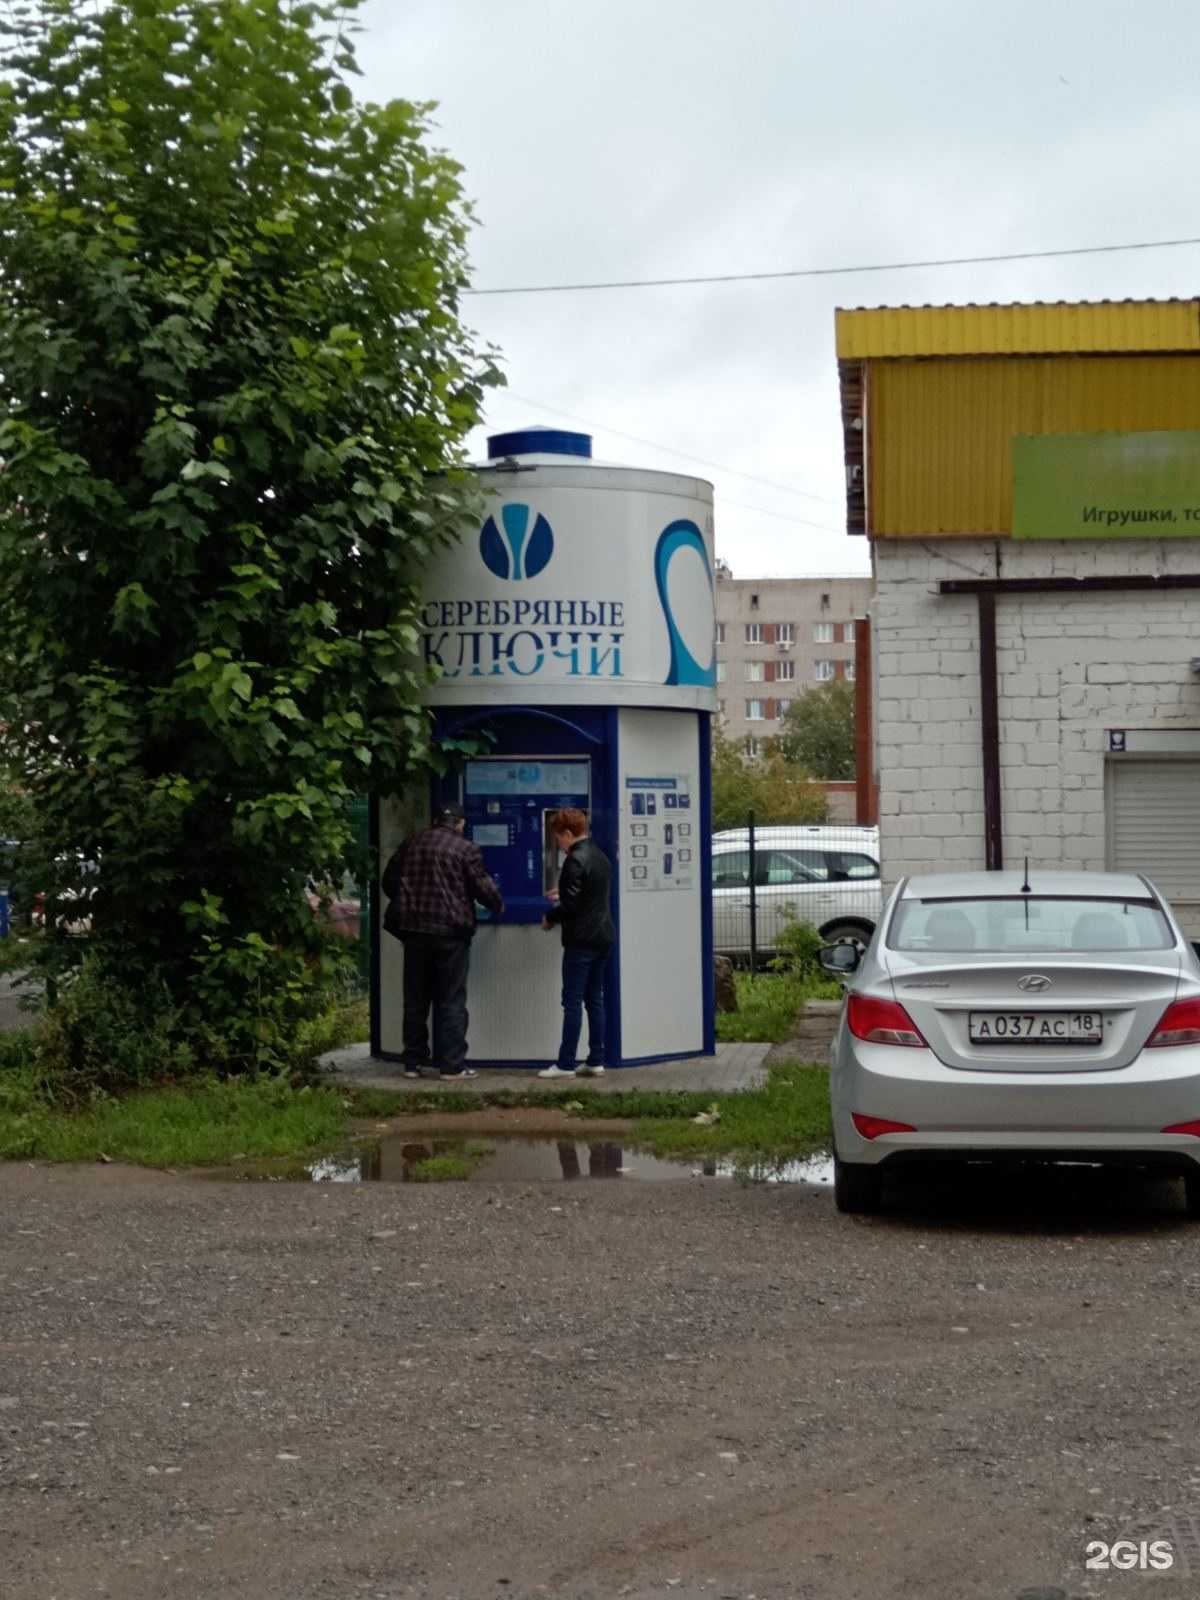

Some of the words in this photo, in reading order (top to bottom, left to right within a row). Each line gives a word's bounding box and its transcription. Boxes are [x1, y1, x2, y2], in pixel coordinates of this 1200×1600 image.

[1083, 507, 1177, 526] Игрушки,
[421, 600, 624, 628] СЕРЕБРЯНЫЕ
[423, 631, 624, 677] КЛЮЧИ
[979, 1016, 1065, 1036] А037АС
[1073, 1015, 1093, 1031] 18
